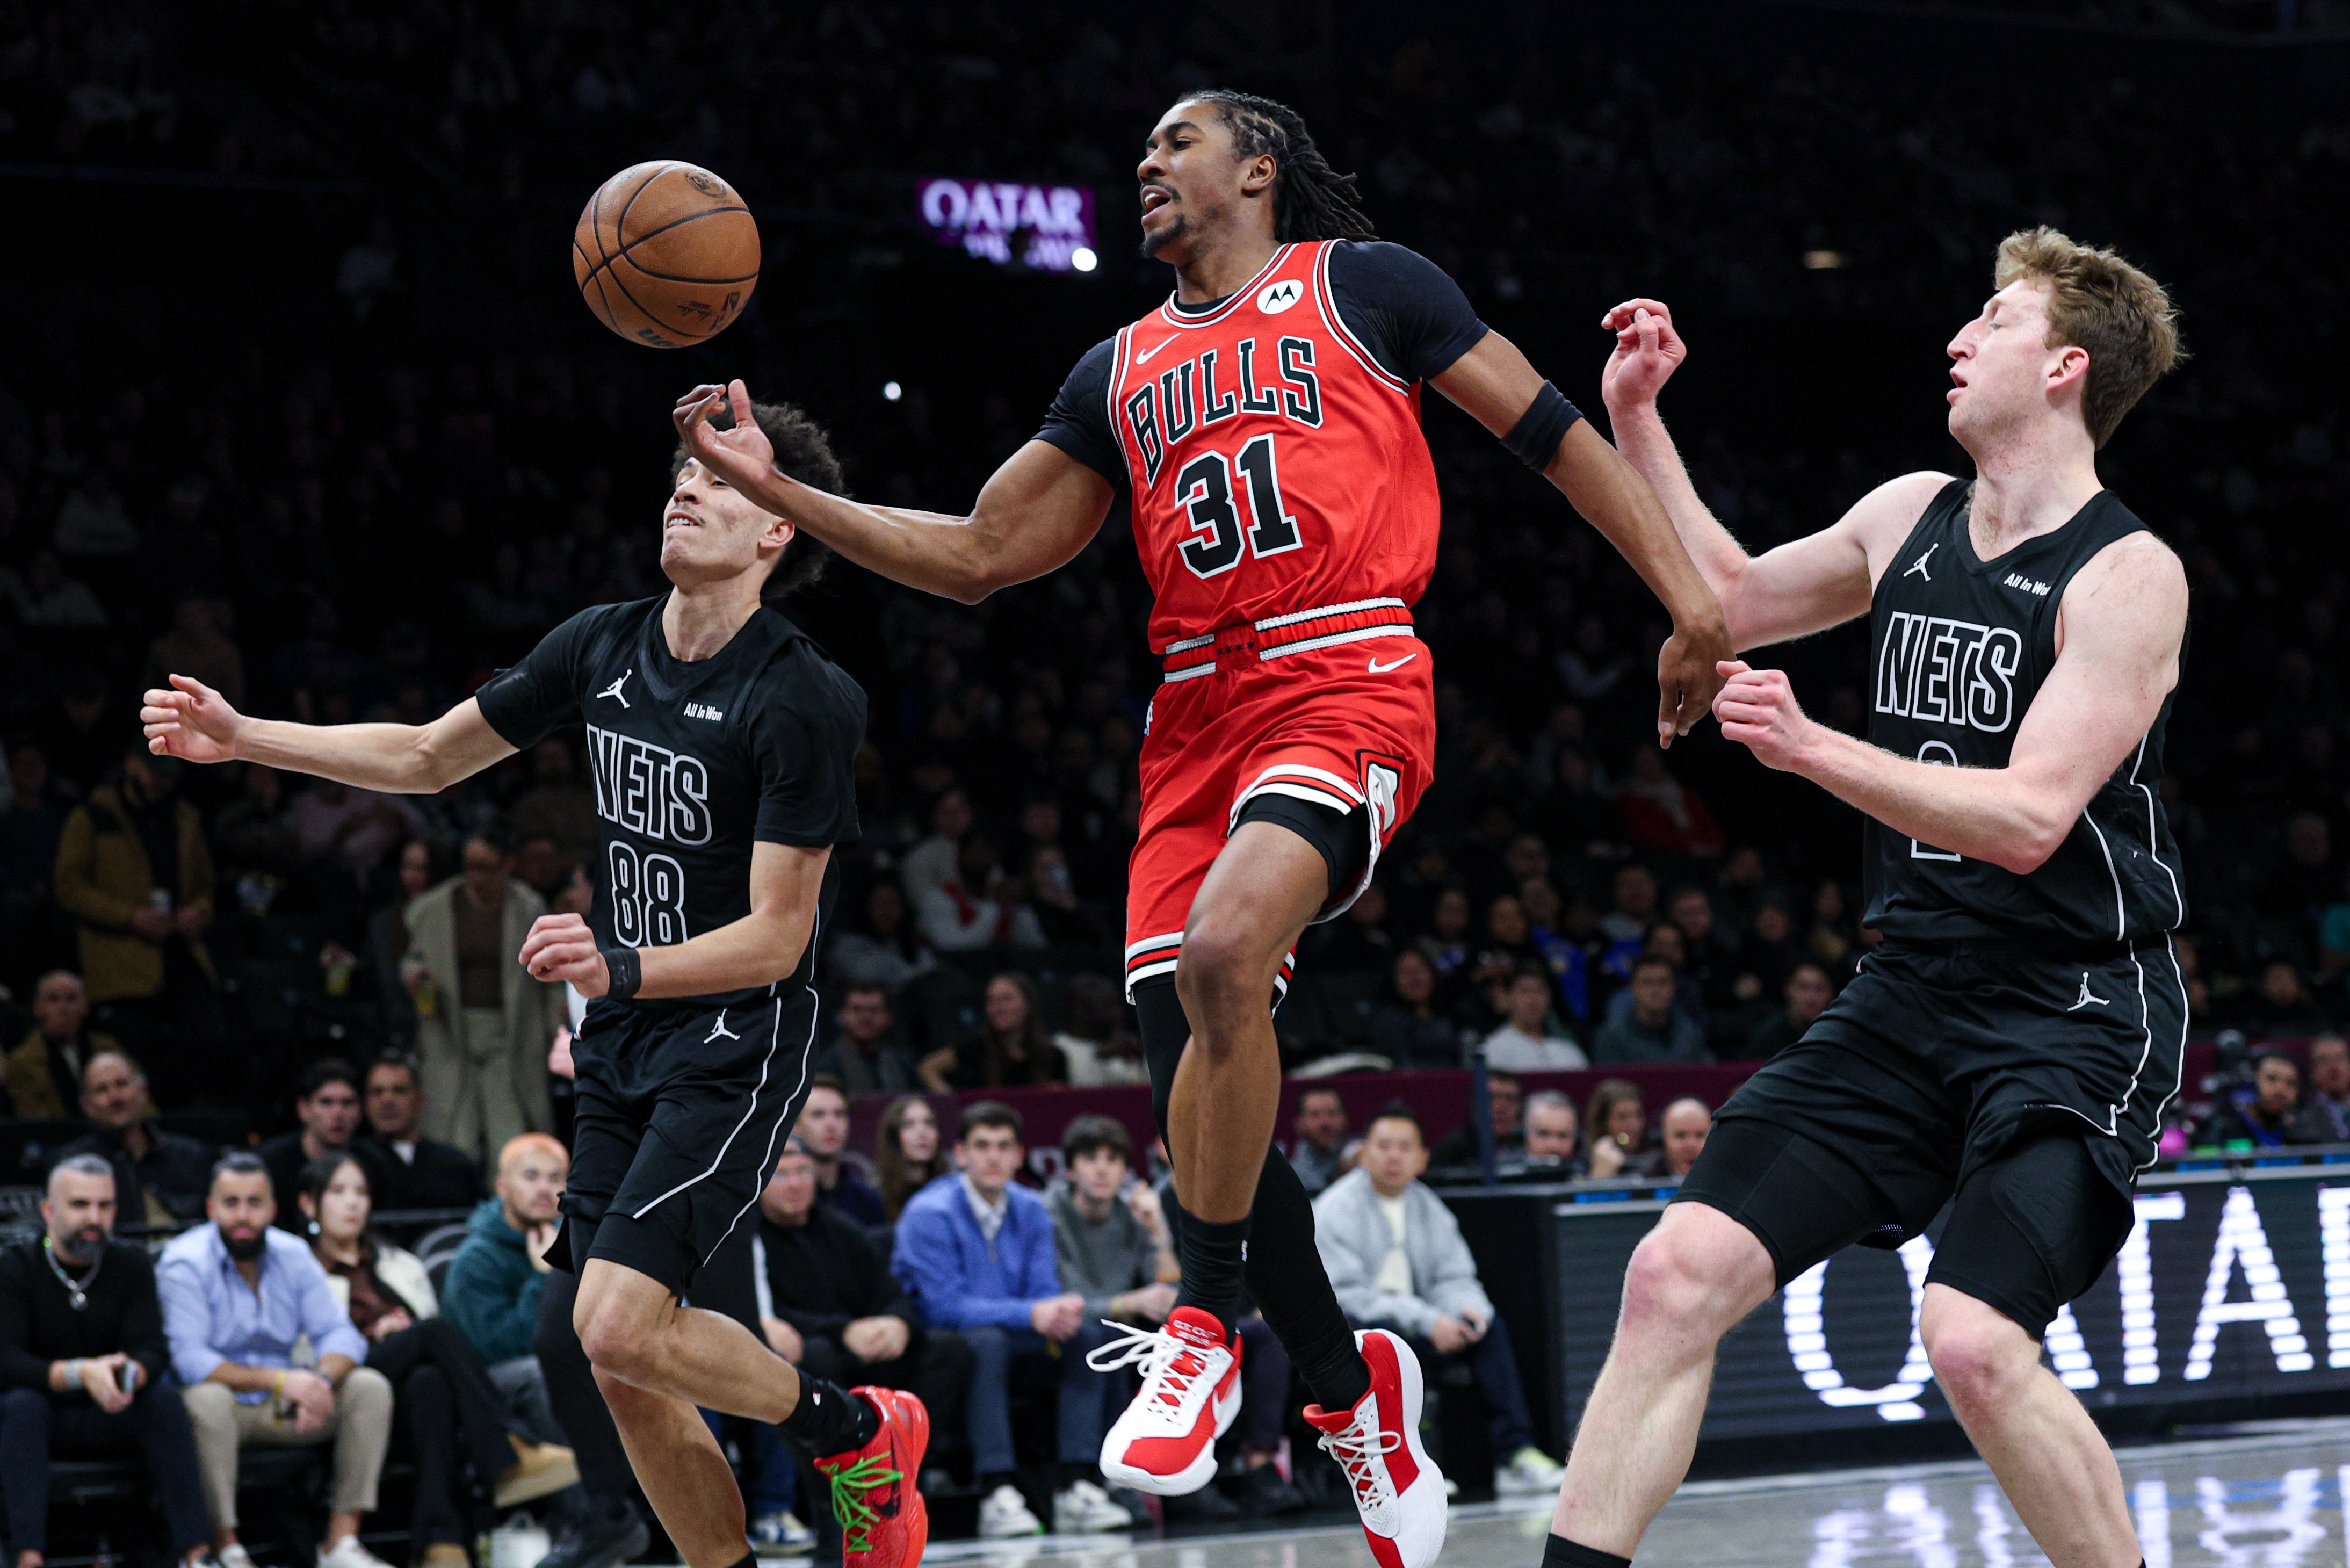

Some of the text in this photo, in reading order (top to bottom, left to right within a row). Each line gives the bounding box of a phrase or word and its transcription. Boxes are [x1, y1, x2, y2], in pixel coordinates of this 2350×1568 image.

[922, 179, 1086, 237] QATAR
[1126, 335, 1324, 490] BULLS
[1174, 432, 1304, 580] 31
[2004, 573, 2023, 588] All
[2019, 577, 2033, 592] In
[683, 702, 723, 722] All In Won
[1875, 611, 2022, 733] NETS
[587, 723, 713, 846] NETS
[609, 840, 688, 949] 88
